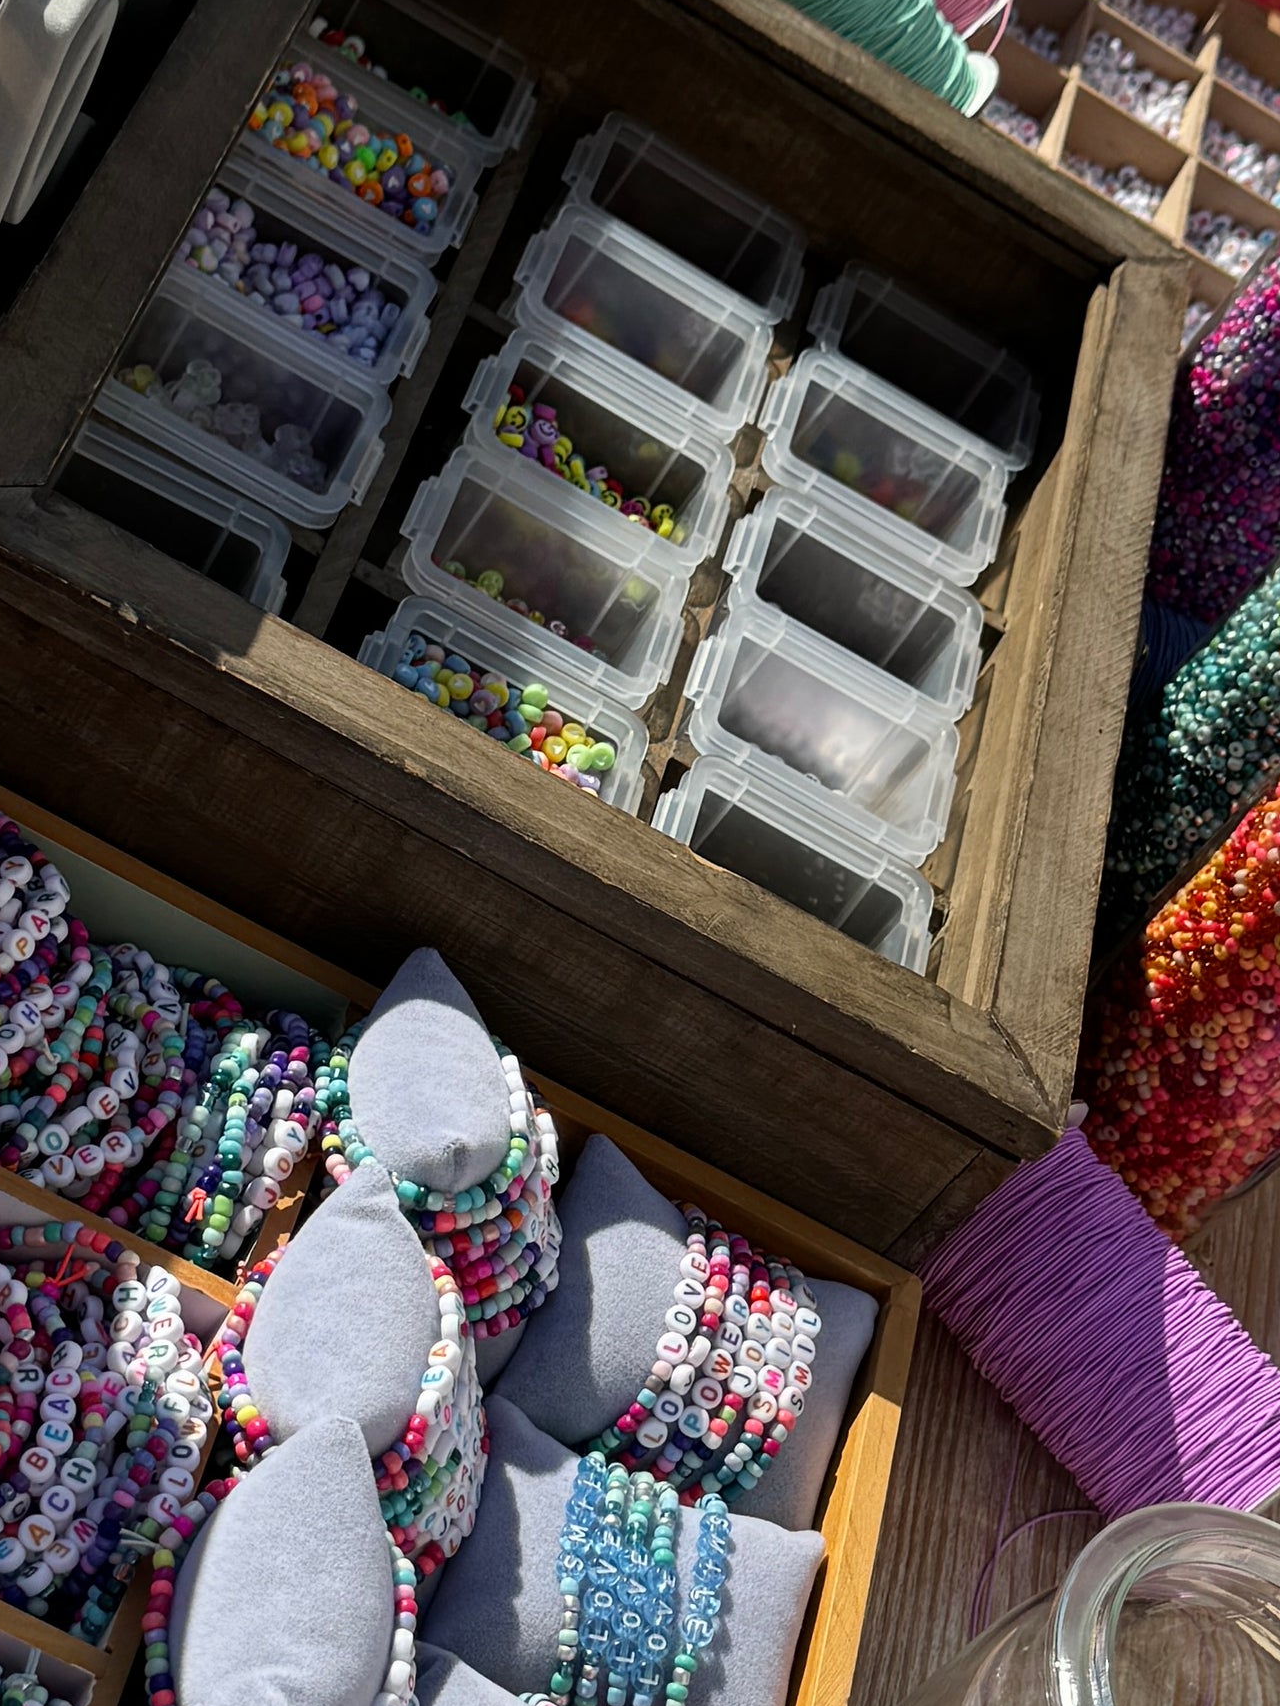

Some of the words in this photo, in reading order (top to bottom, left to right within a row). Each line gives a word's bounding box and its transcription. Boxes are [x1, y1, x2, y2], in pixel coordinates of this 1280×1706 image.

[662, 1256, 708, 1354] LOVE
[737, 1315, 769, 1388] JOY
[751, 1292, 796, 1413] SMILE
[26, 1350, 73, 1472] BEACH
[682, 1300, 748, 1434] POWER
[588, 1532, 620, 1643] LOVE
[615, 1552, 649, 1664] LOVE
